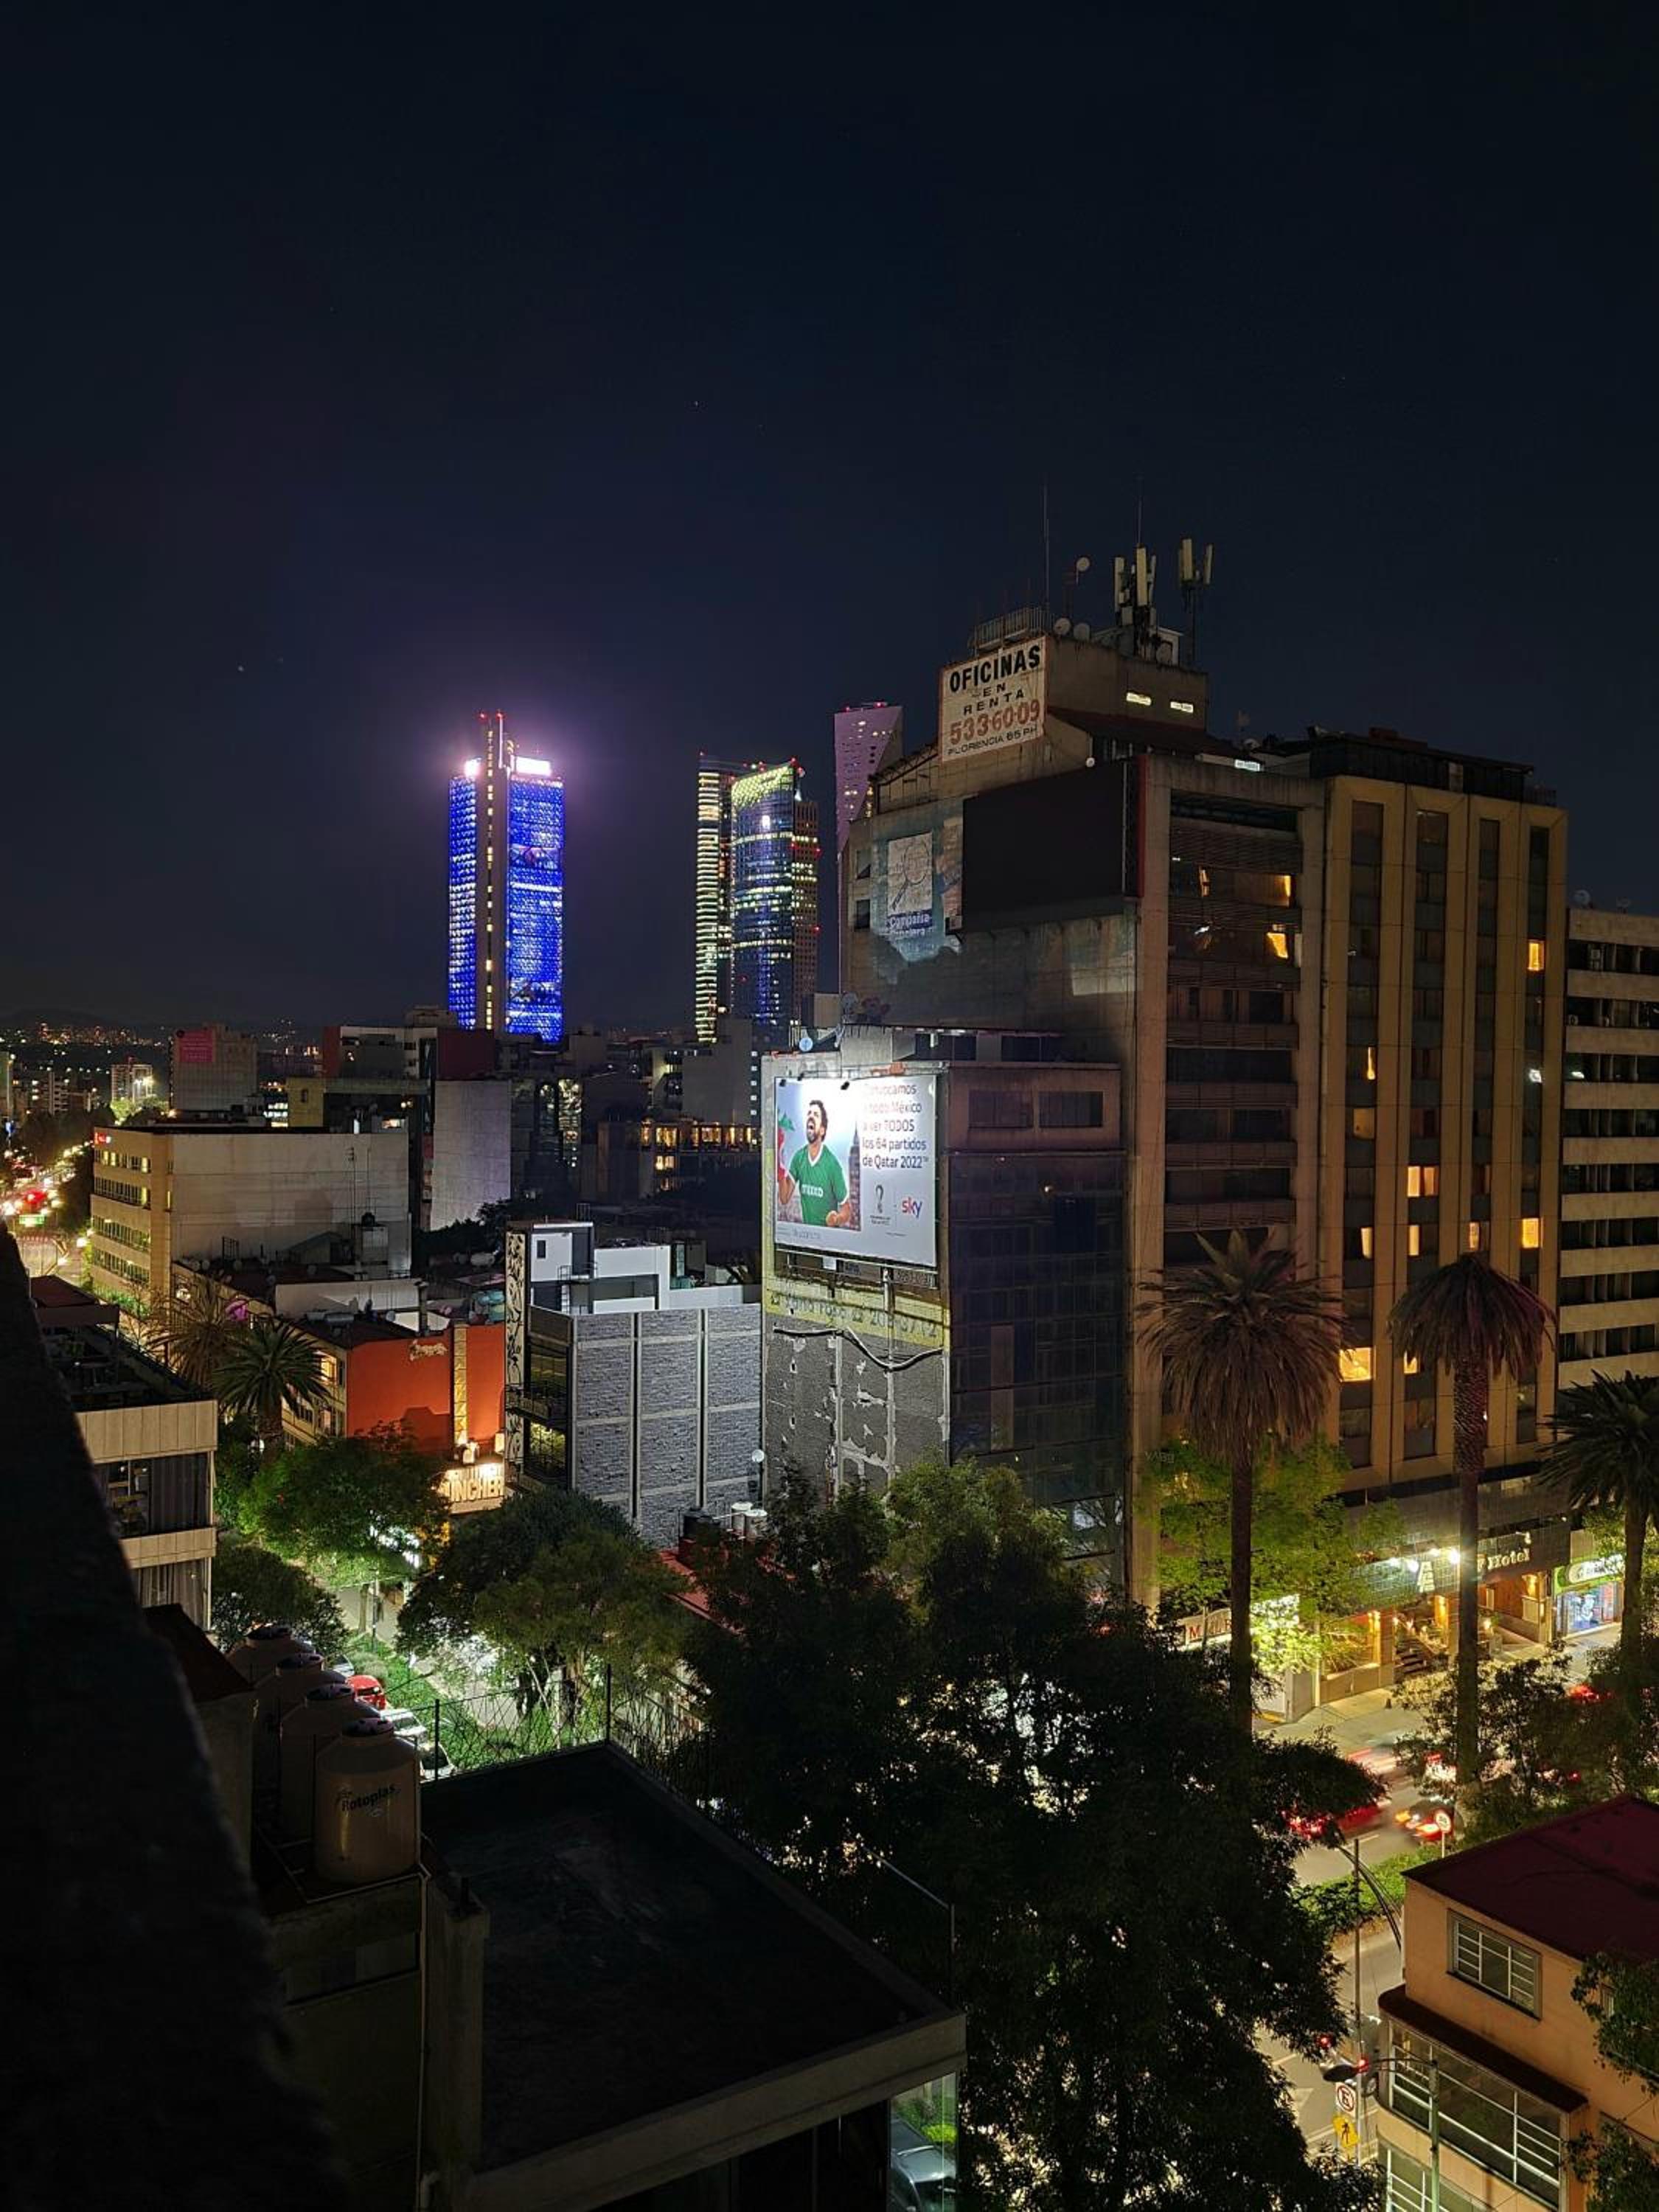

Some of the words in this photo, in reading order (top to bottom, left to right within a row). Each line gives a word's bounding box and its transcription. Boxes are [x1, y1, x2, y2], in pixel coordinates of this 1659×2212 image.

[950, 645, 1040, 692] OFICINAS
[983, 682, 1006, 697] EN
[964, 689, 1024, 715] RENTA
[947, 737, 1005, 755] FLORENCIA
[884, 1119, 915, 1133] TODOS
[862, 1138, 874, 1150] los
[876, 1138, 888, 1150] 64
[889, 1138, 927, 1152] partidos
[862, 1155, 873, 1167] de
[874, 1155, 898, 1170] Qatar
[902, 1196, 923, 1219] sky
[1488, 1548, 1530, 1571] Hotel
[341, 1784, 397, 1812] Rotoplas
